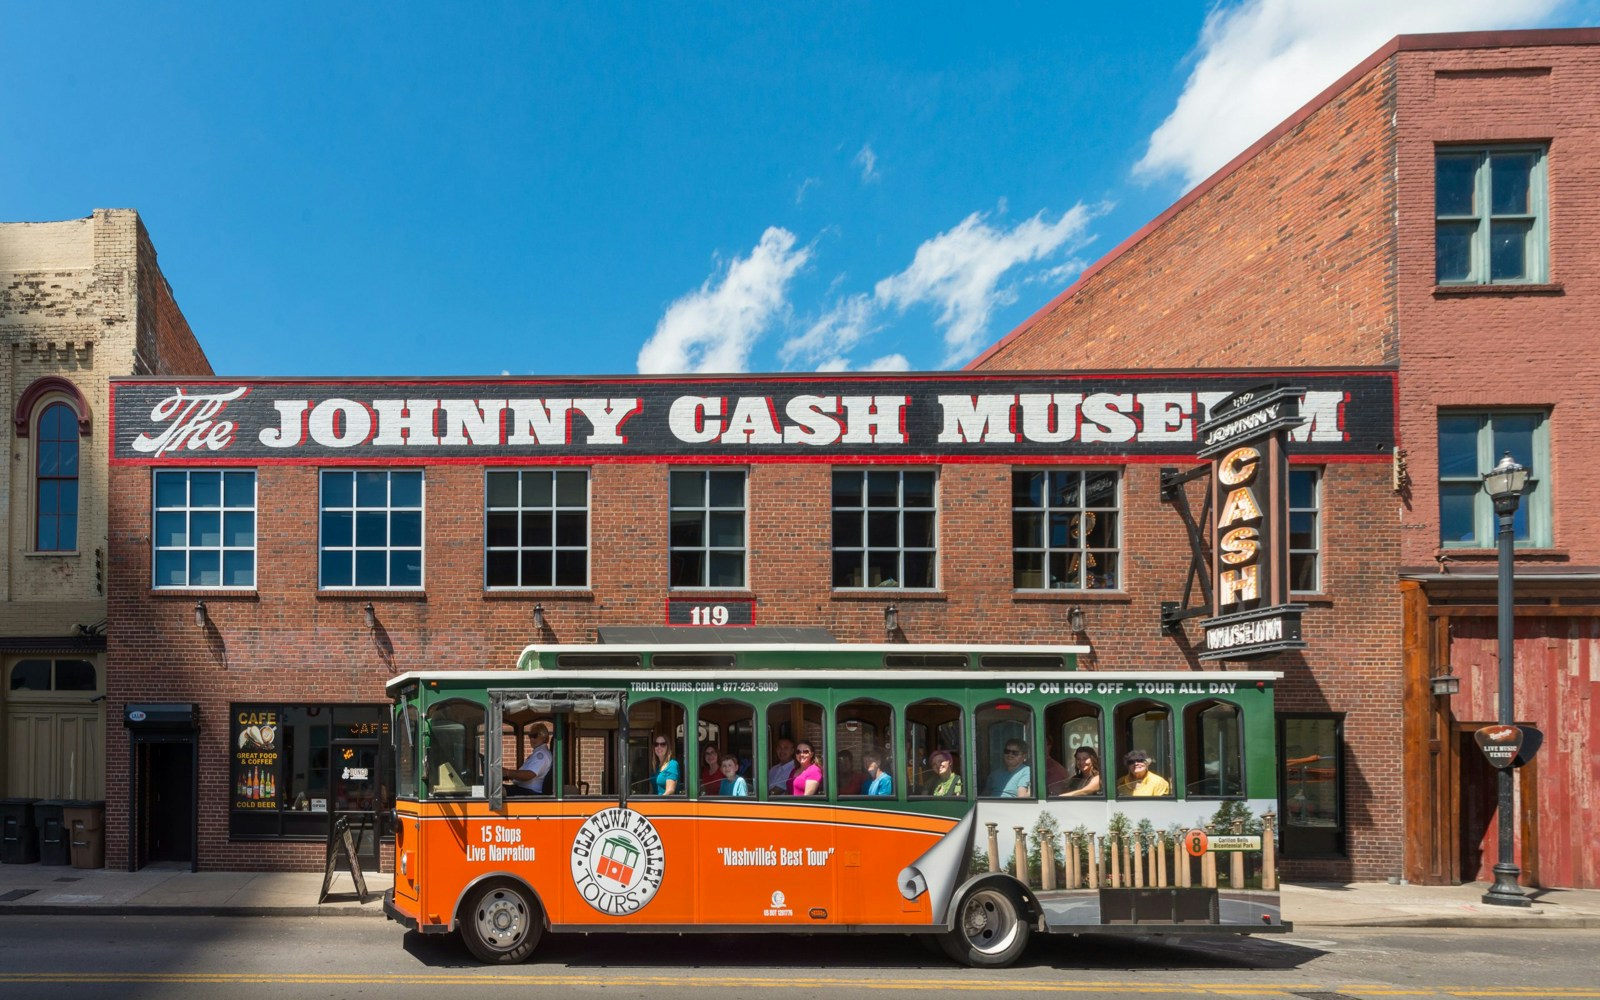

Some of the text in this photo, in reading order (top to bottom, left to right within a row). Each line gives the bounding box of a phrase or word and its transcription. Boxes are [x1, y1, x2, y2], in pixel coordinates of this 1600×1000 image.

[131, 386, 1350, 458] The JOHNNY CASH MUSEM
[1204, 402, 1282, 446] JOHNNY
[1218, 446, 1264, 606] CASH
[690, 604, 729, 626] 119
[1206, 616, 1283, 650] MUSEUM
[630, 681, 715, 692] TROLLEYTOURS.COM
[1006, 682, 1237, 694] HOP ON HOP OFF TOUR ALL DAY
[238, 712, 277, 725] CAFE
[480, 825, 522, 845] 15 Stops
[1192, 837, 1202, 853] 8
[466, 844, 536, 862] Live Narration
[573, 809, 663, 889] OLD TOWN TROLLEY
[780, 847, 804, 866] Best
[576, 867, 641, 914] TOURS
